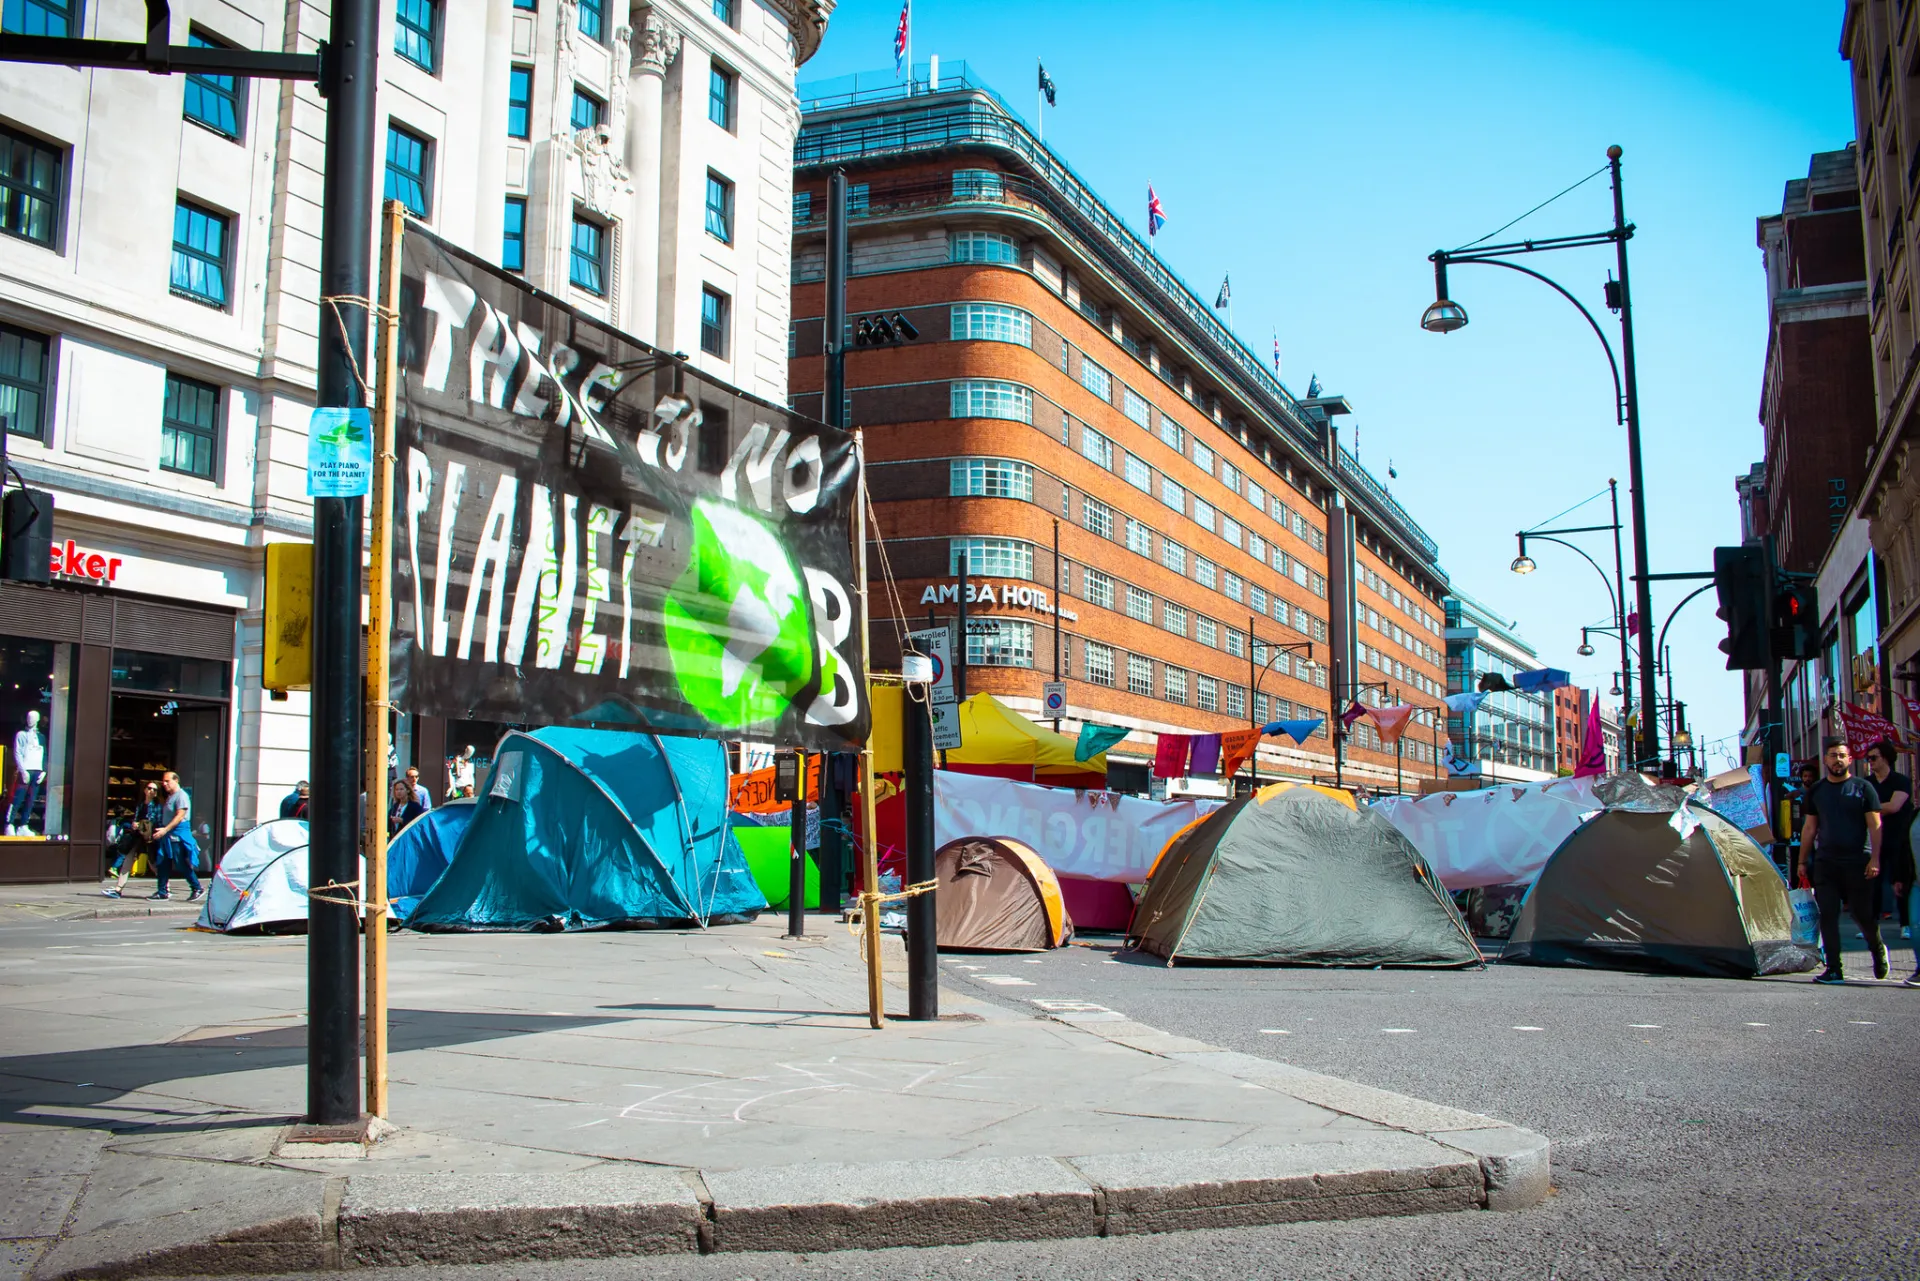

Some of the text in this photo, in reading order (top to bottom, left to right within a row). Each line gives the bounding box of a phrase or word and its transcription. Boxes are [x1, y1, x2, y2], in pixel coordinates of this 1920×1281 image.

[320, 461, 360, 469] PLAY PIANO
[328, 470, 340, 478] THE
[721, 420, 823, 514] NO
[50, 538, 122, 581] cker
[407, 446, 666, 680] PLANET
[920, 584, 1049, 612] AMBA HOTEL
